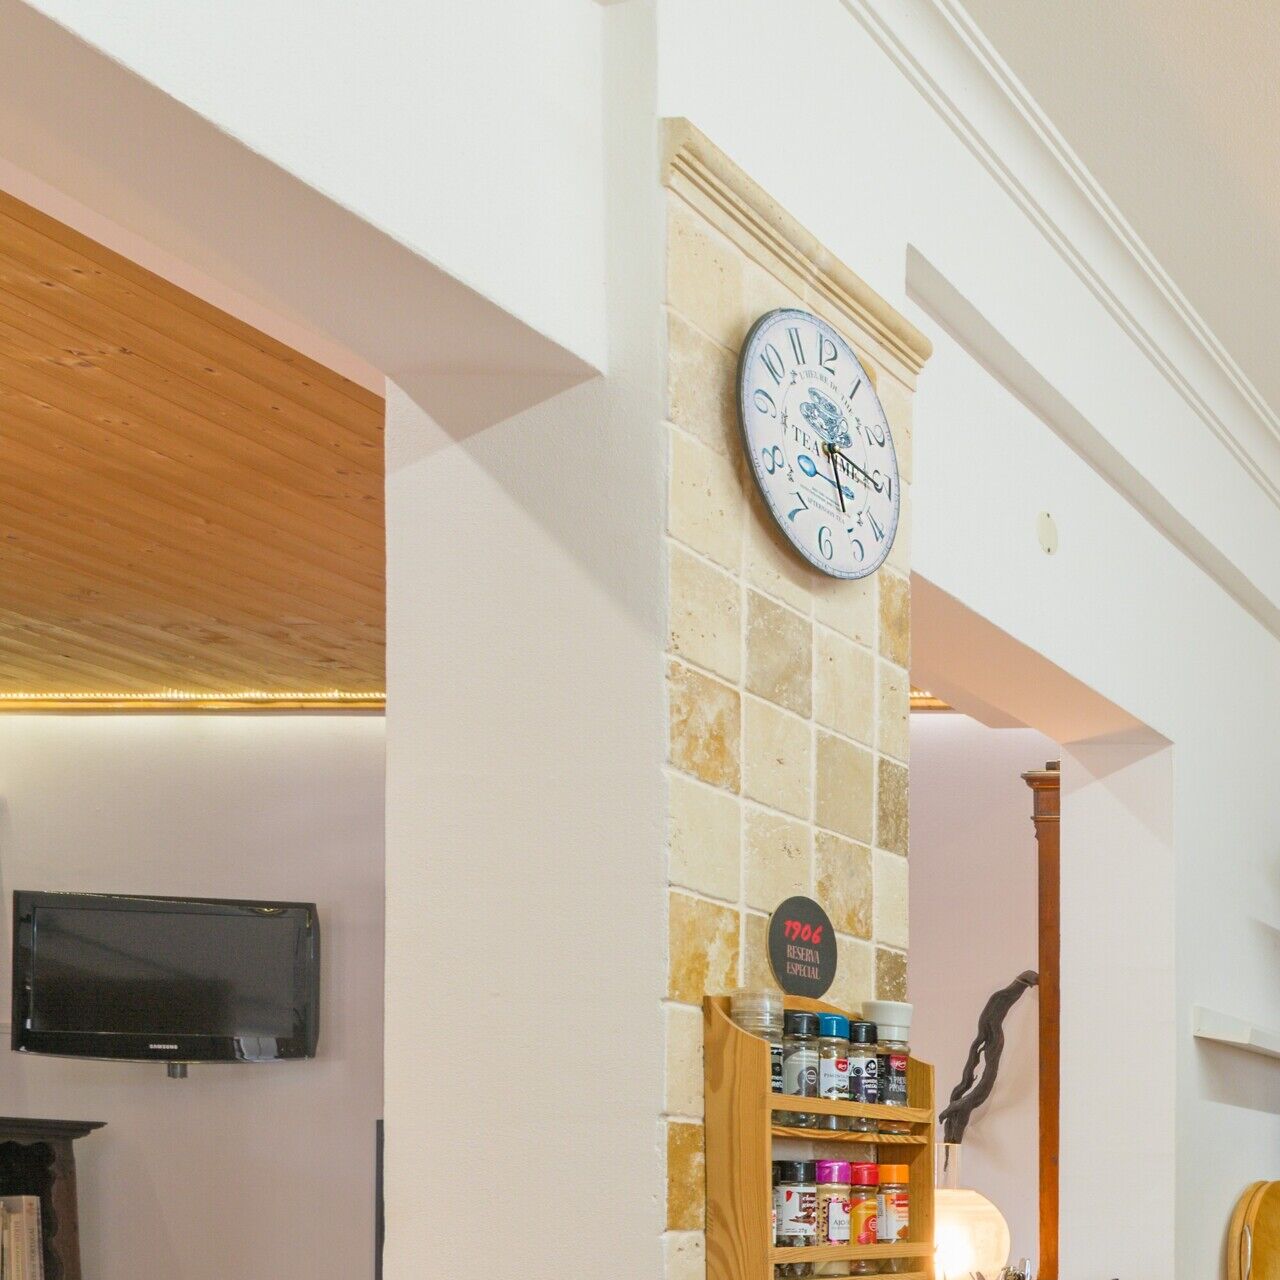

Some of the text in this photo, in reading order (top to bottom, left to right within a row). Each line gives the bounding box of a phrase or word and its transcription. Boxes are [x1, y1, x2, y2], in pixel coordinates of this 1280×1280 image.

[787, 327, 806, 365] 11
[817, 331, 838, 376] 12
[760, 343, 785, 386] 10
[849, 375, 862, 400] 1
[753, 388, 777, 419] 9
[791, 424, 820, 457] TEA
[864, 424, 886, 448] 2
[762, 445, 784, 475] 8
[871, 469, 892, 501] 3
[787, 491, 809, 522] 7
[866, 506, 885, 543] 4
[818, 525, 833, 561] 6
[847, 527, 865, 562] 5
[784, 920, 825, 946] 1906
[786, 944, 820, 964] RESERVA
[786, 961, 820, 980] ESPECIAL
